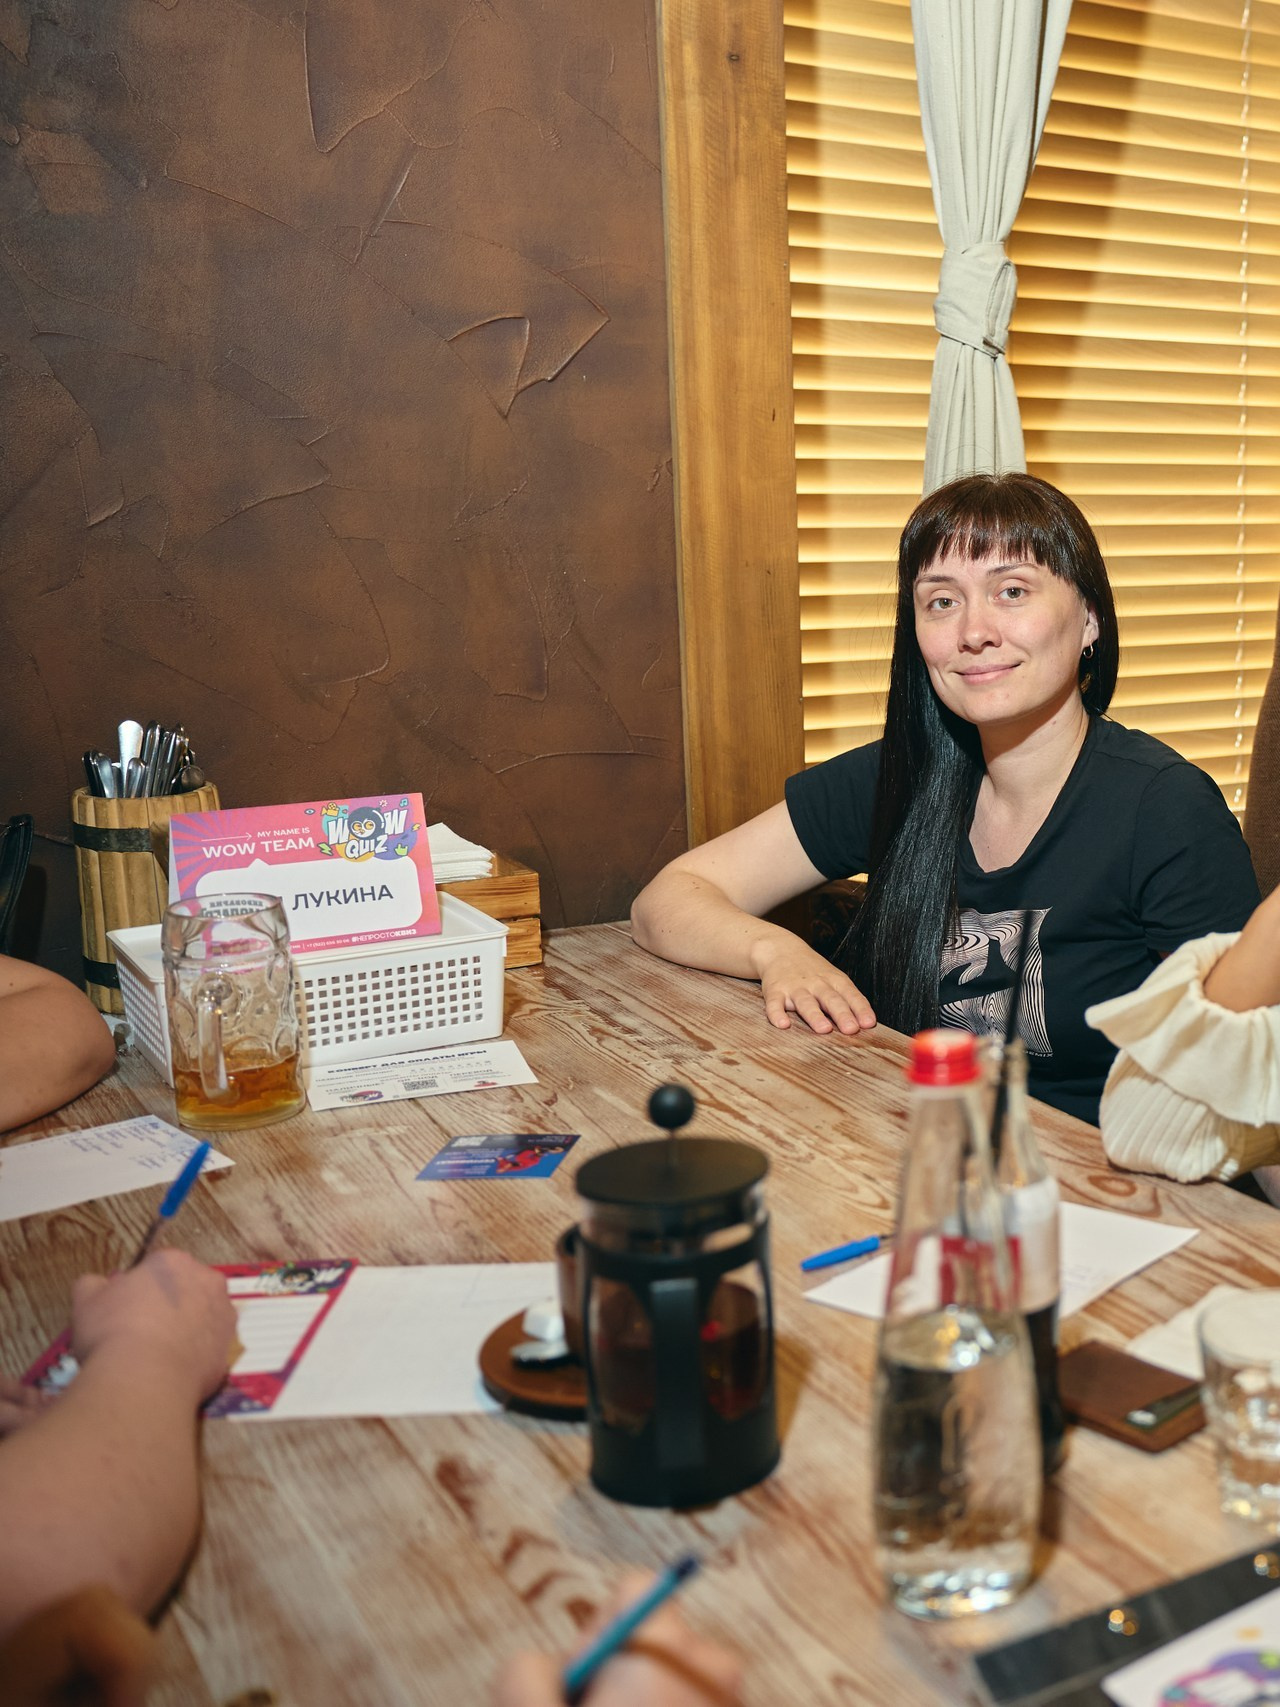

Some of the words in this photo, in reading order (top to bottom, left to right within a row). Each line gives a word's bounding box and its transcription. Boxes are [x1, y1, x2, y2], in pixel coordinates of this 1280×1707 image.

[257, 830, 272, 838] MY
[273, 828, 300, 837] NAME
[327, 807, 408, 846] WOW
[202, 842, 256, 859] WOW
[261, 837, 315, 853] TEAM
[345, 835, 388, 859] QUIZ
[292, 884, 394, 911] ЛУКИНА
[351, 928, 417, 943] #НЕПРОСТОКВИЗ
[327, 1063, 378, 1074] КОНВЕРТ
[381, 1060, 405, 1068] ДЛЯ
[407, 1053, 456, 1064] ОПЛАТЫ
[457, 1050, 488, 1058] ИГРЫ
